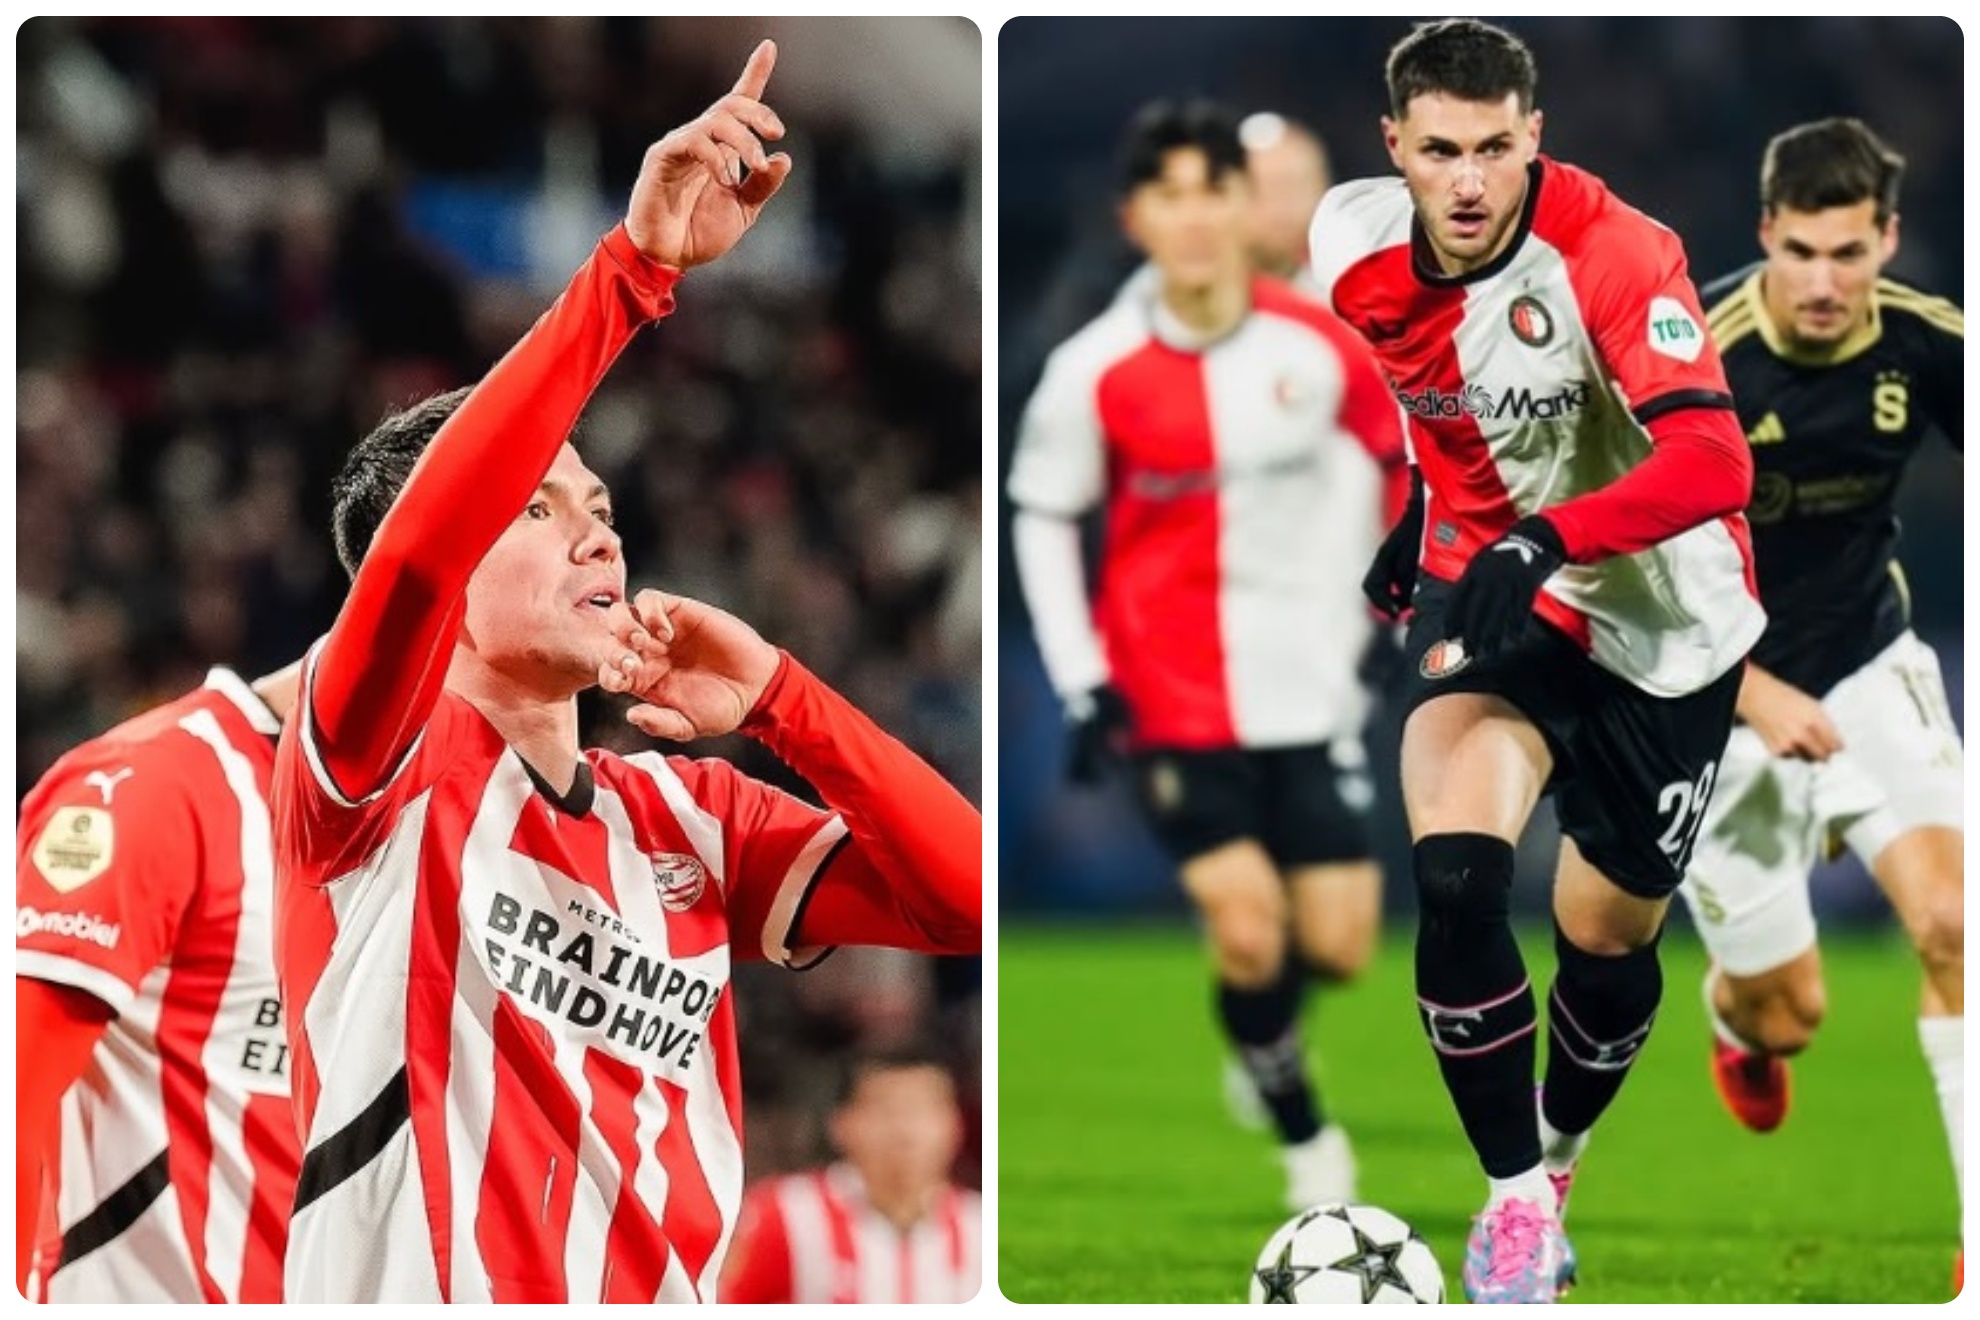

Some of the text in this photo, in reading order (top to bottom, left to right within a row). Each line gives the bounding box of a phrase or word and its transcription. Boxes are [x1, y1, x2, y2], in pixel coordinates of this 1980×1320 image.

[1389, 378, 1460, 417] edia
[1873, 384, 1908, 432] S
[1656, 760, 1716, 871] 29
